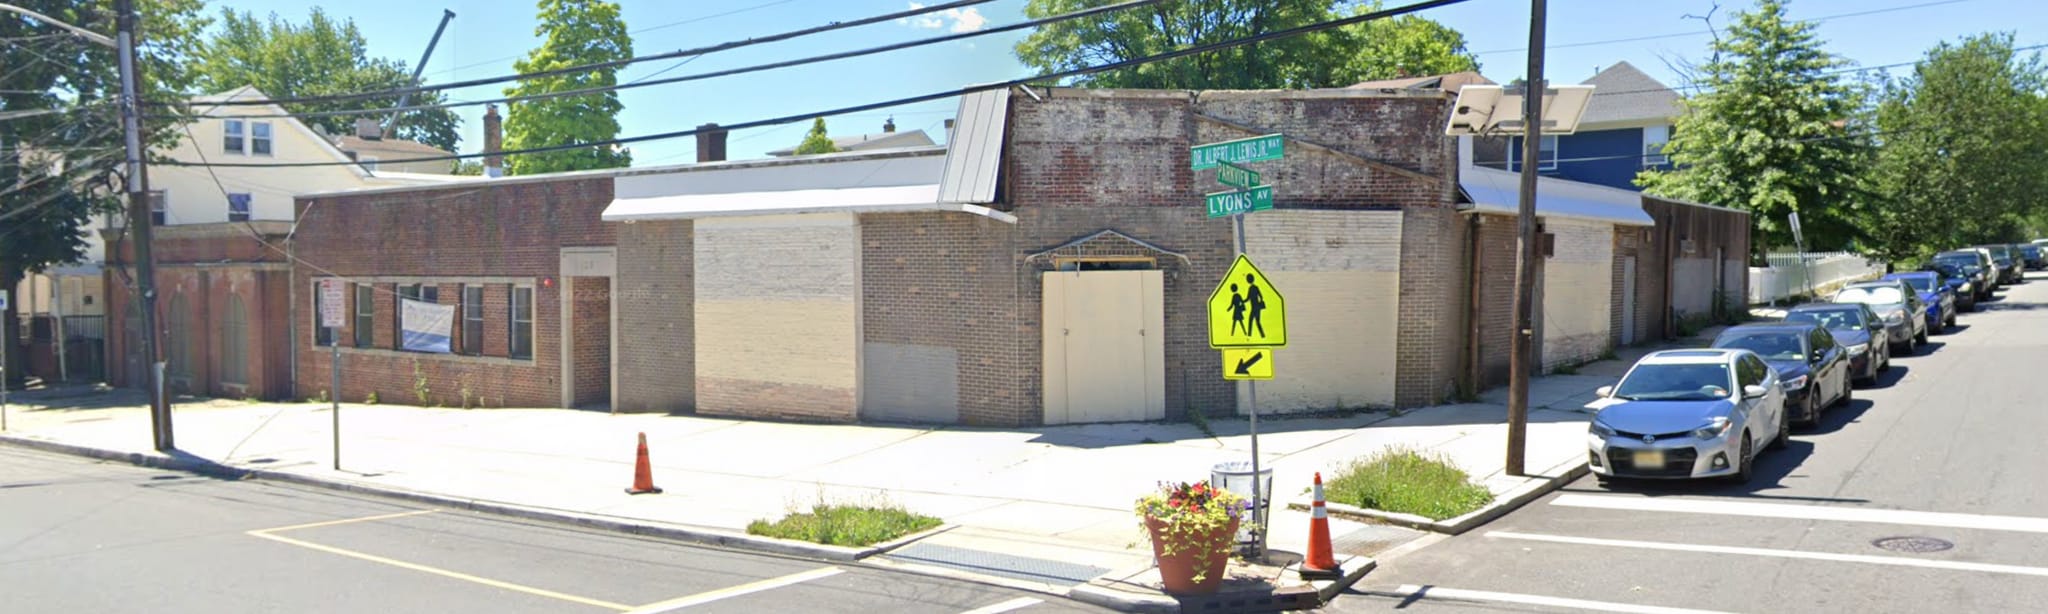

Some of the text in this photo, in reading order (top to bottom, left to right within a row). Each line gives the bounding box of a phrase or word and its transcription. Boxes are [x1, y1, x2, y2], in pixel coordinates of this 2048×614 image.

[1193, 150, 1203, 166] DR.
[1205, 146, 1228, 164] ALBERT
[1237, 141, 1257, 160] LEWIS
[1268, 138, 1280, 149] WAY
[1209, 190, 1268, 214] LYONS AV
